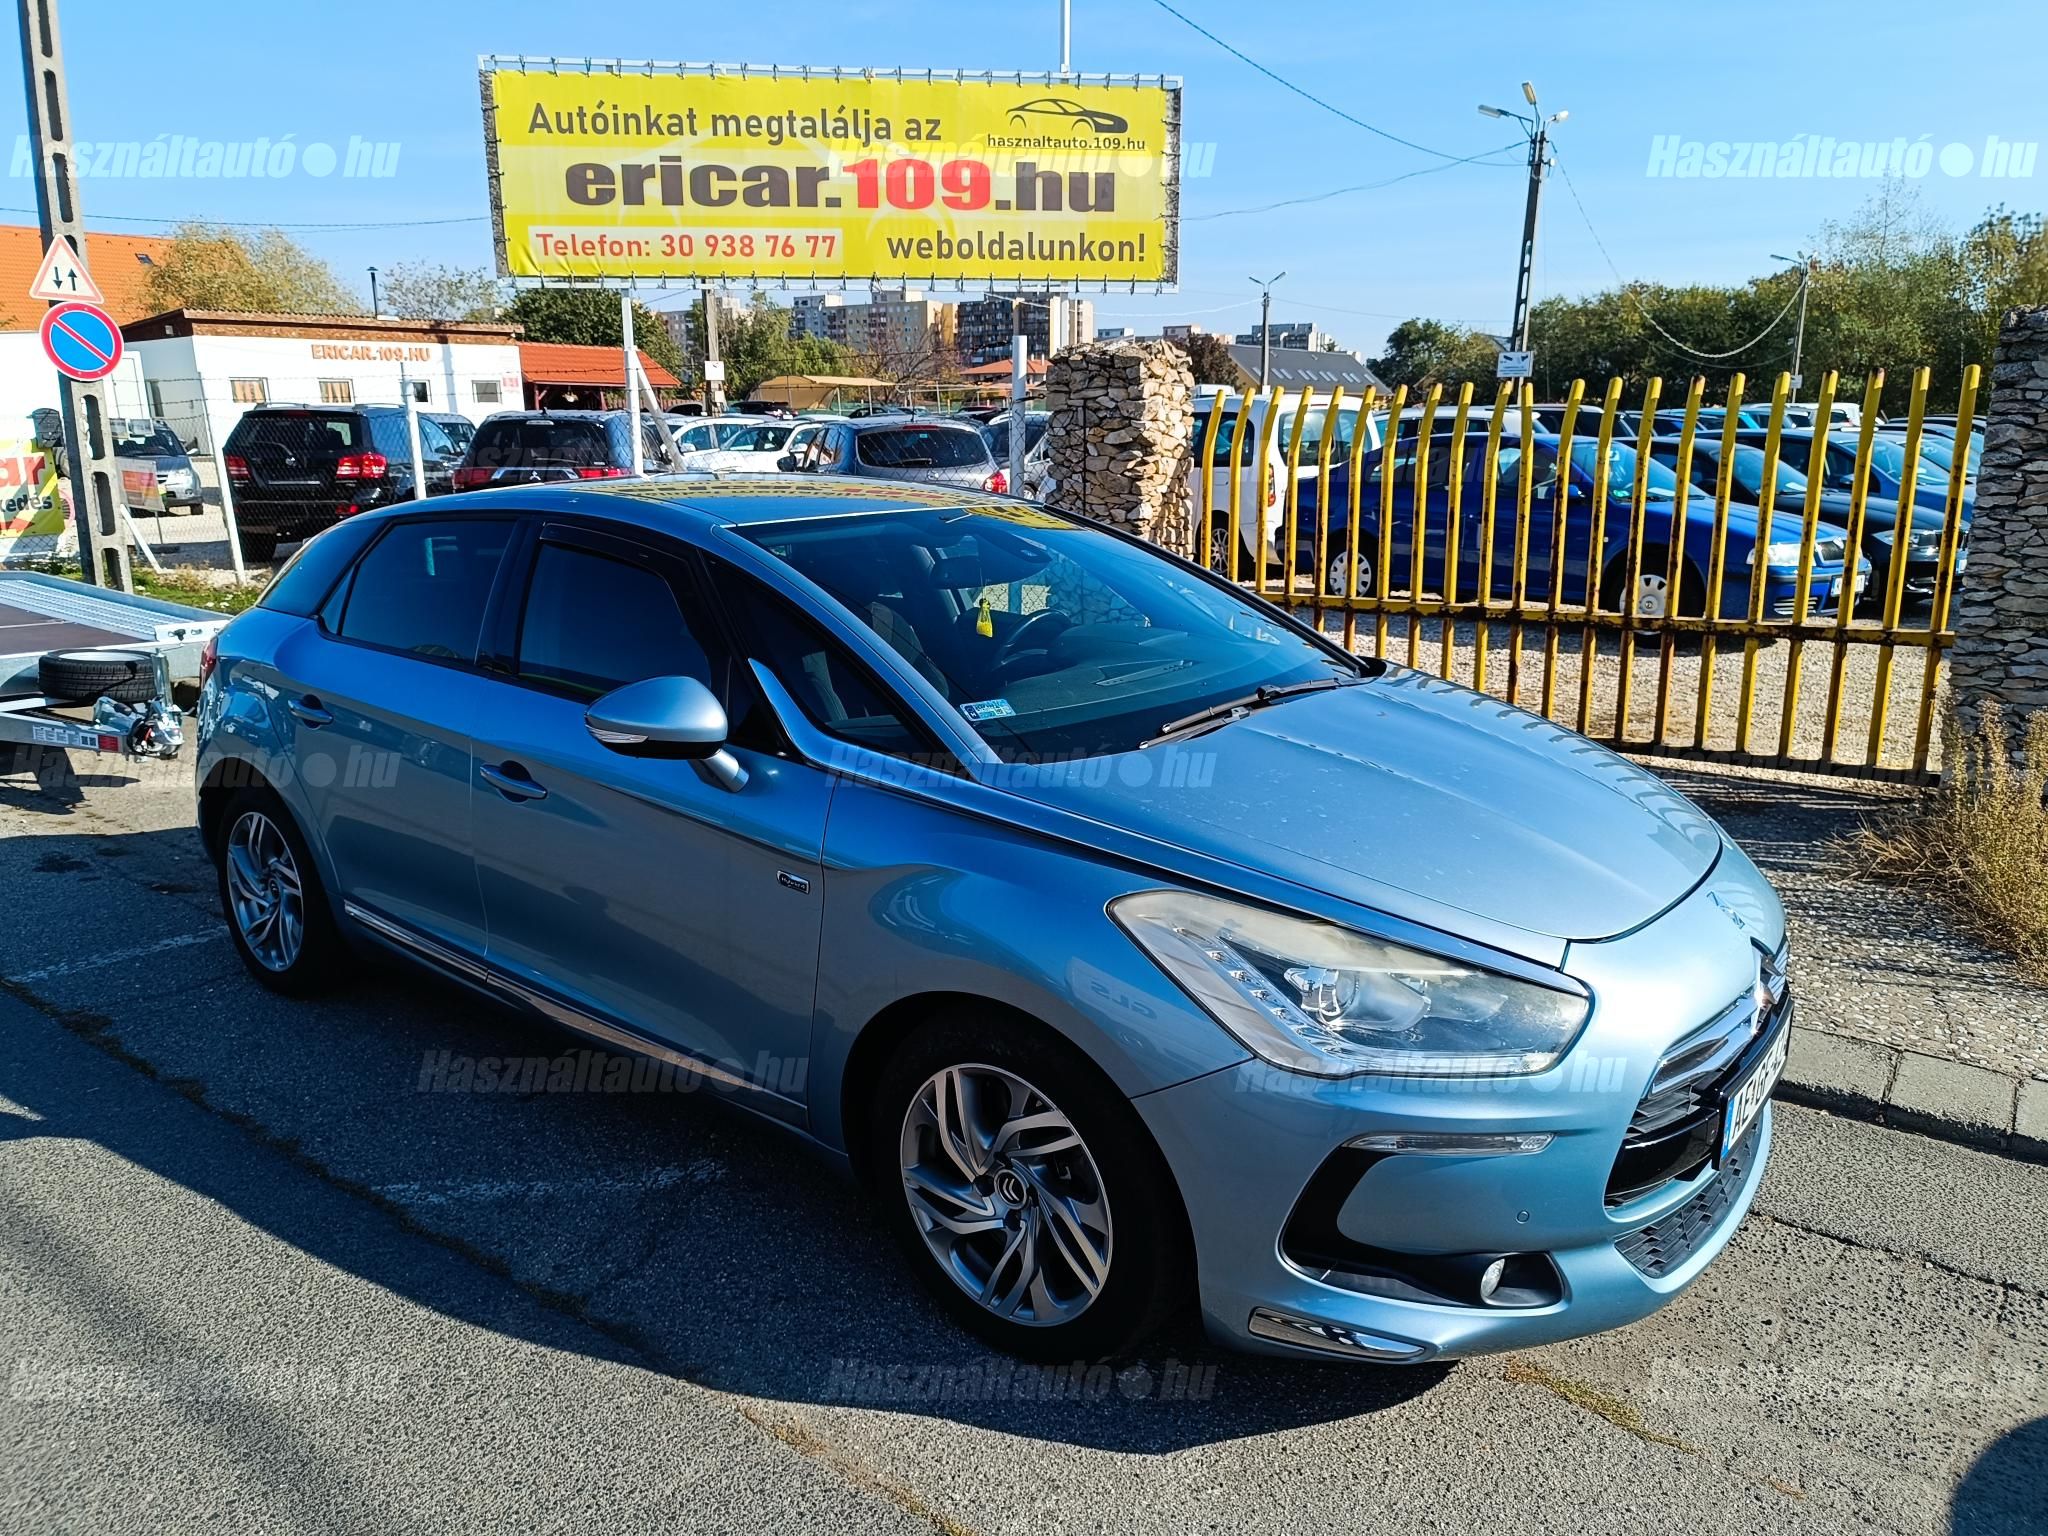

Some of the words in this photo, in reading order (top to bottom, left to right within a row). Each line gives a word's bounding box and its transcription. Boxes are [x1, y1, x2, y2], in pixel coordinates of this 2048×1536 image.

[527, 100, 698, 137] Autóinkat
[711, 104, 892, 148] megtalálja
[904, 117, 942, 141] az
[987, 133, 1146, 150] hasznaltauto.109.hu
[565, 155, 1116, 213] ericar.109.hu
[535, 233, 651, 257] Telefon:
[660, 234, 694, 257] 30
[705, 235, 755, 258] 938
[764, 235, 796, 258] 76
[805, 235, 836, 258] 77
[886, 230, 1146, 262] weboldalunkon!
[311, 344, 431, 361] ERICAR.109.HU
